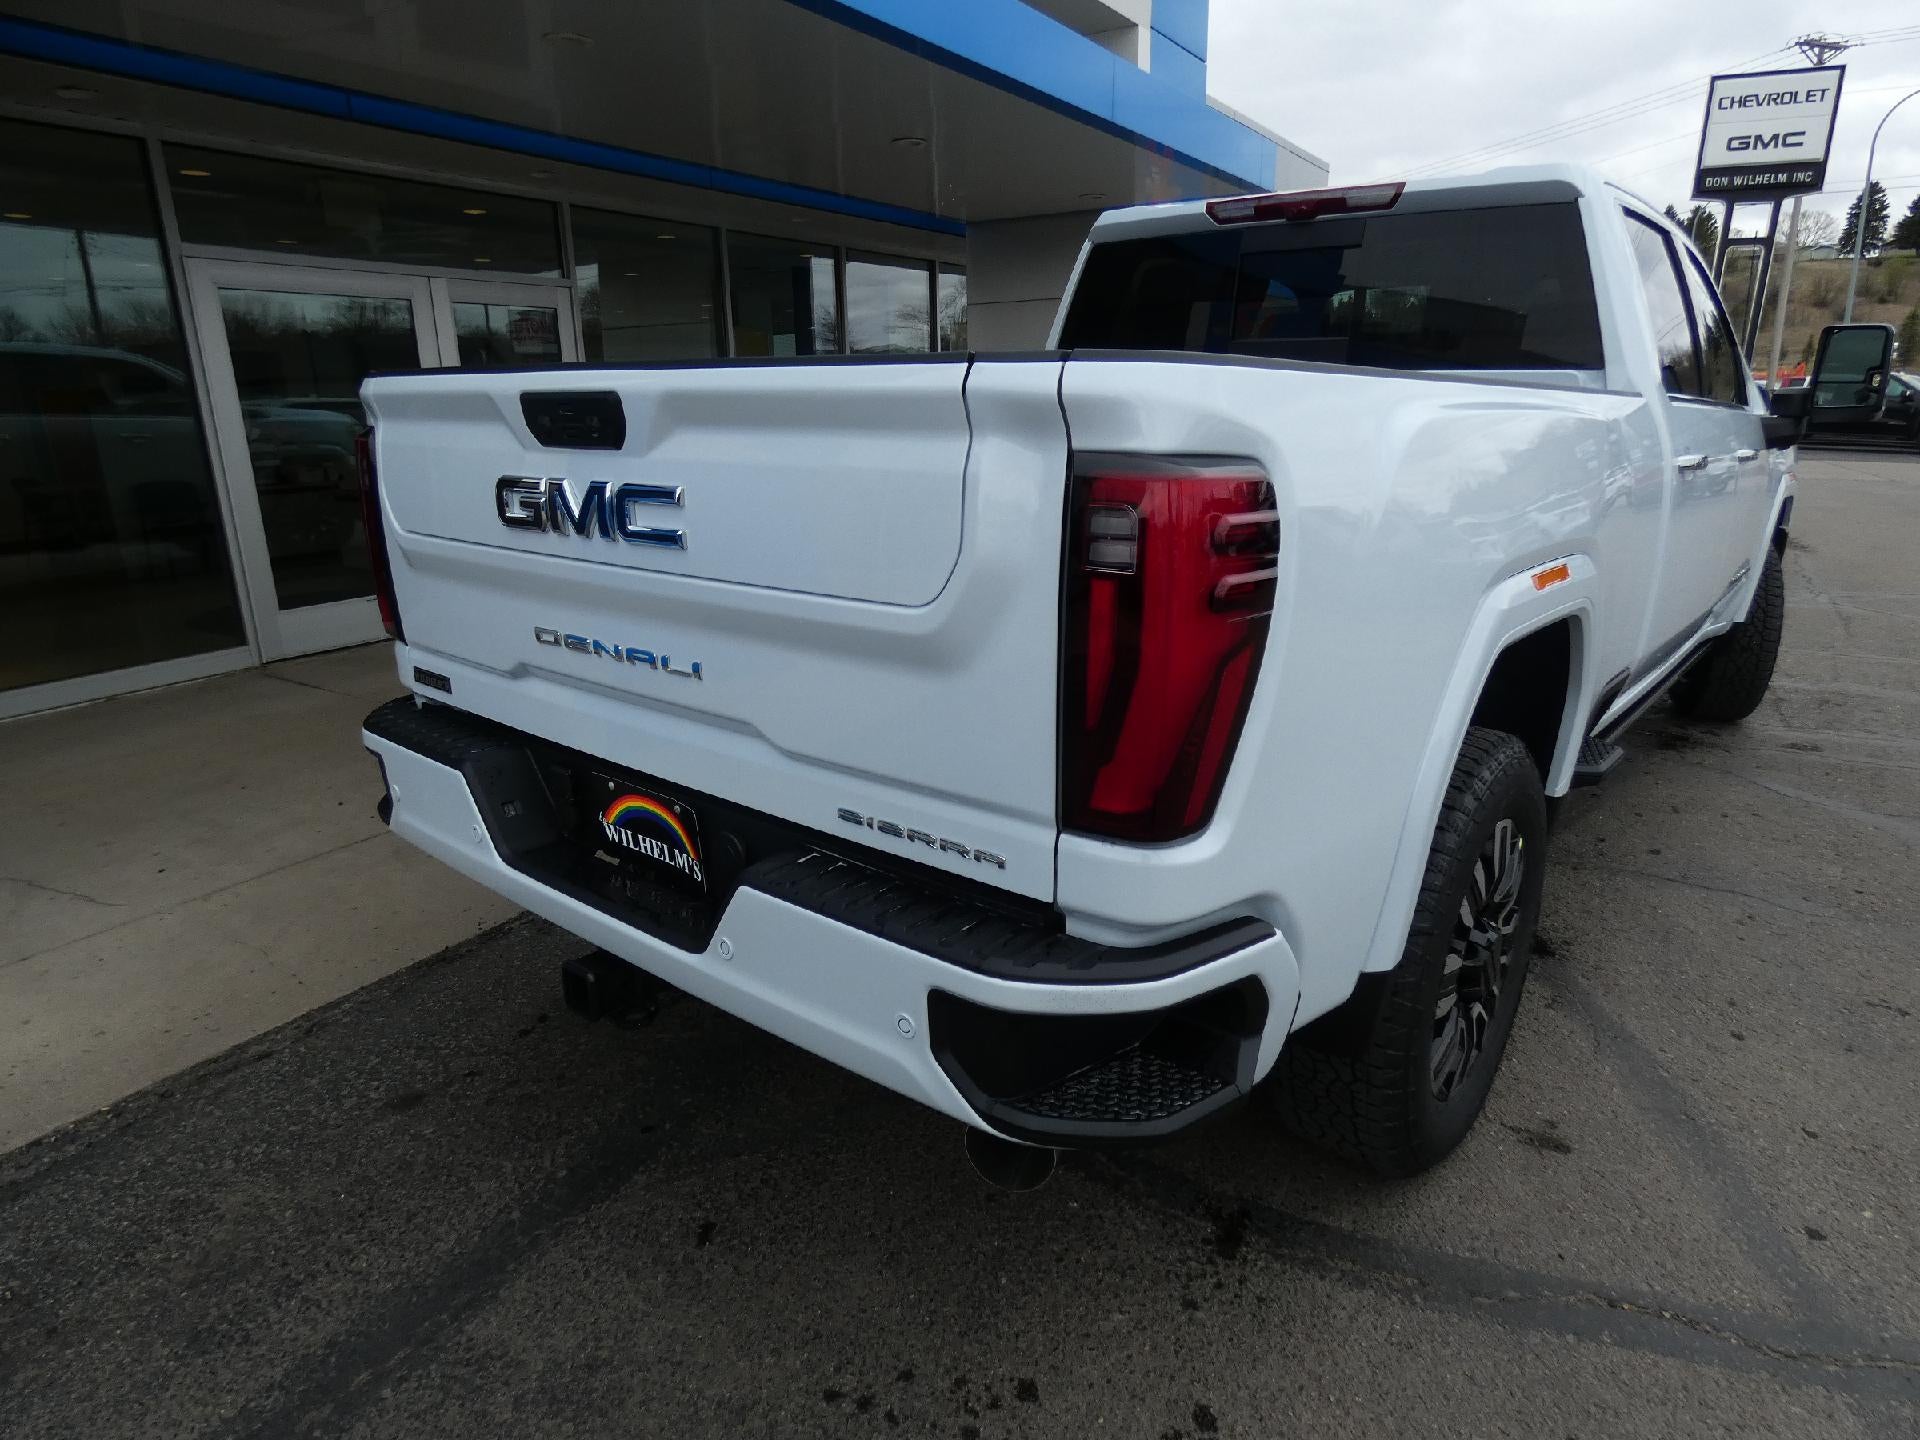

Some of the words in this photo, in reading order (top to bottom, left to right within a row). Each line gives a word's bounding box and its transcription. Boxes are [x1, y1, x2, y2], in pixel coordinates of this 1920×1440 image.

[1717, 88, 1830, 111] CHEVROLET
[1726, 131, 1806, 152] GMC
[1705, 176, 1729, 187] DON
[1733, 172, 1788, 186] WILHELM
[1792, 171, 1813, 182] INC
[495, 474, 688, 550] GMC
[533, 626, 703, 680] DENALI
[599, 811, 702, 881] WILHELM'S
[837, 807, 1006, 870] SIERRA
